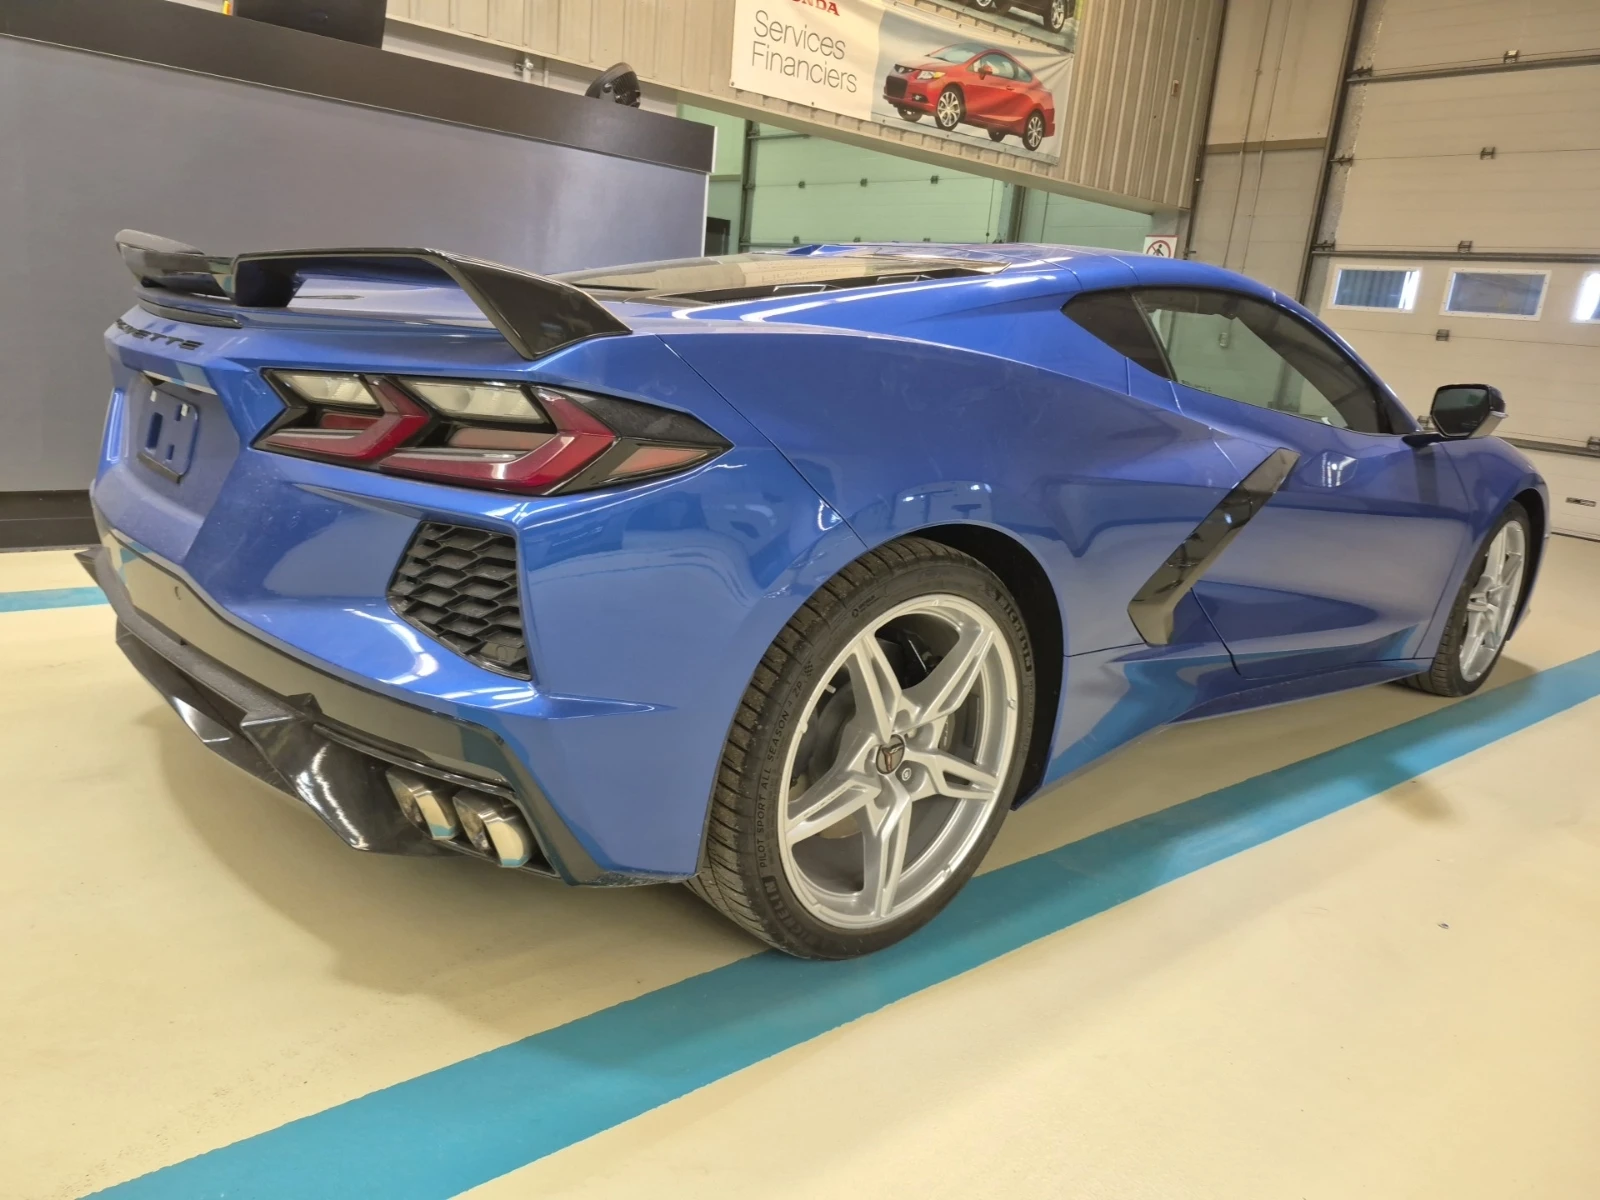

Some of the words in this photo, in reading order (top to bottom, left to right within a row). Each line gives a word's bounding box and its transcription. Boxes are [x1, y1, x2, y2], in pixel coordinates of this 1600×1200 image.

[754, 10, 846, 60] Services
[752, 41, 857, 93] Financiers
[767, 710, 790, 762] SEASON
[761, 767, 772, 790] ALL
[757, 796, 767, 833] SPORT
[758, 839, 768, 868] PILOT
